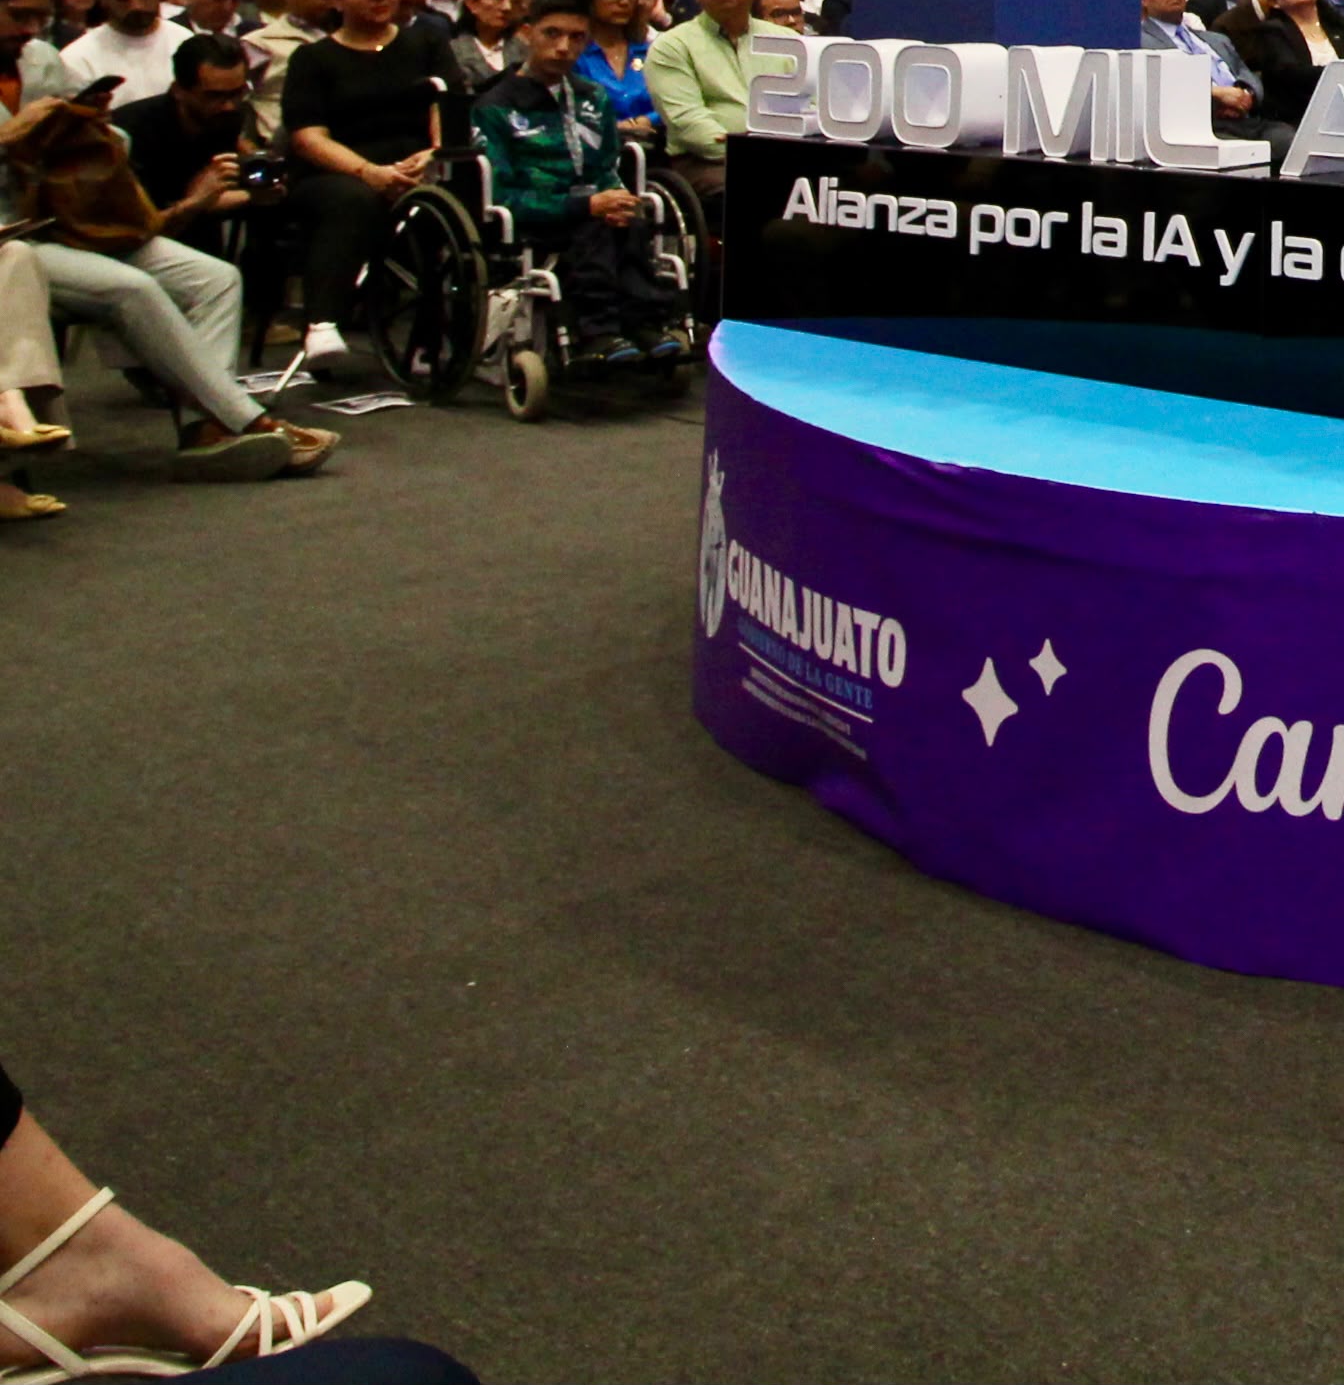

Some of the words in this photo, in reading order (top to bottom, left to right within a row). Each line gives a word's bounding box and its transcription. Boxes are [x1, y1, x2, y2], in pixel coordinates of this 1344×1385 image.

[747, 34, 1005, 150] 200
[1003, 44, 1271, 171] MIL
[783, 175, 958, 240] Alianza
[969, 203, 1069, 256] por
[1081, 200, 1128, 259] la
[1142, 210, 1202, 269] IA
[1214, 230, 1256, 287] y
[1270, 220, 1325, 282] la
[726, 538, 907, 689] GUANAJUATO
[823, 672, 874, 710] GENTE
